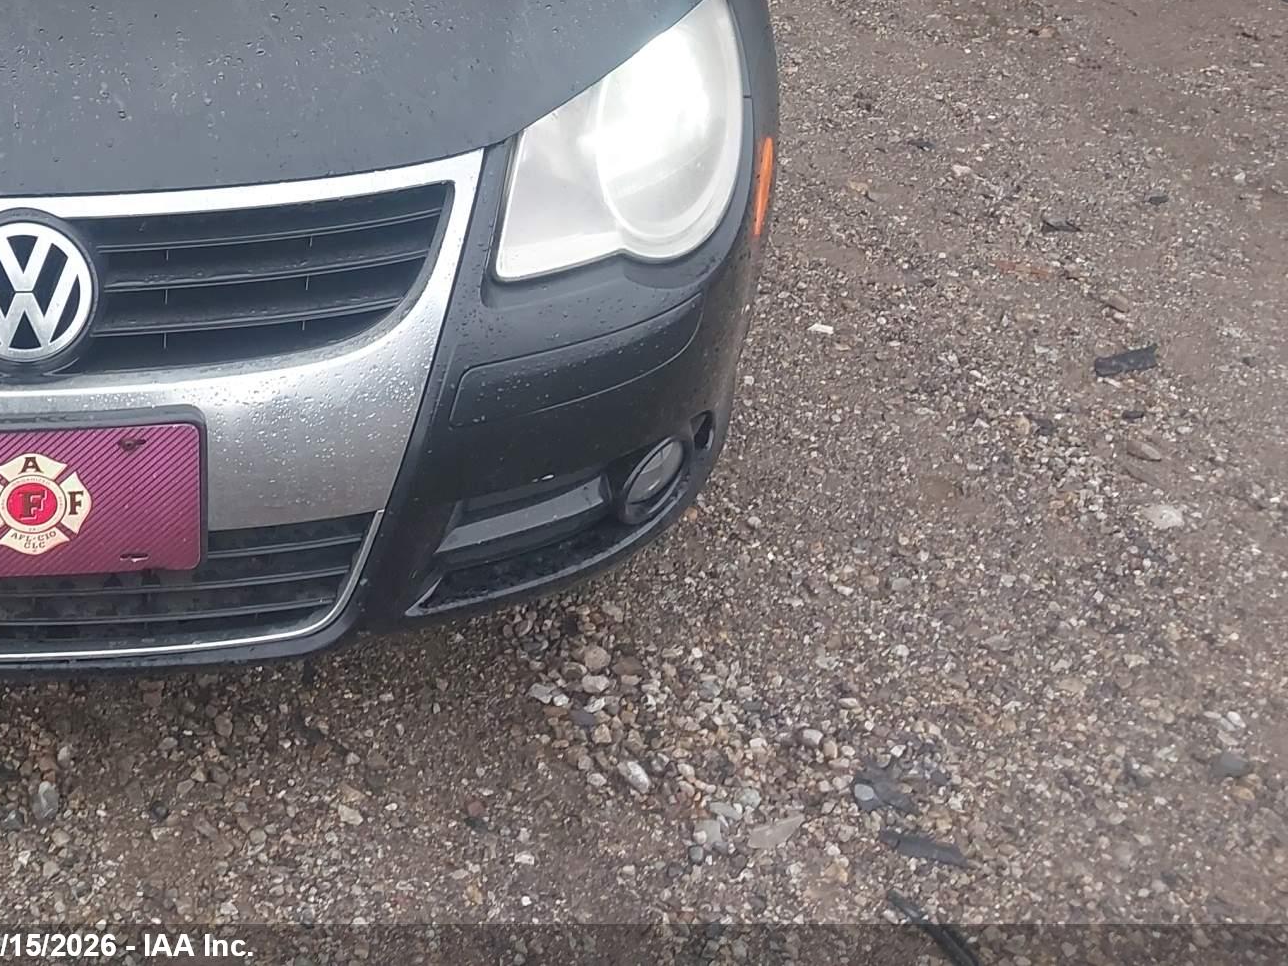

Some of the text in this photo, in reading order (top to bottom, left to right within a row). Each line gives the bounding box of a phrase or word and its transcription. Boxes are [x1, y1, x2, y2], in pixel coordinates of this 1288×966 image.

[18, 456, 44, 475] A
[18, 489, 47, 520] F
[68, 490, 84, 516] F
[10, 530, 57, 542] AFL-CIO
[23, 540, 46, 550] CLC
